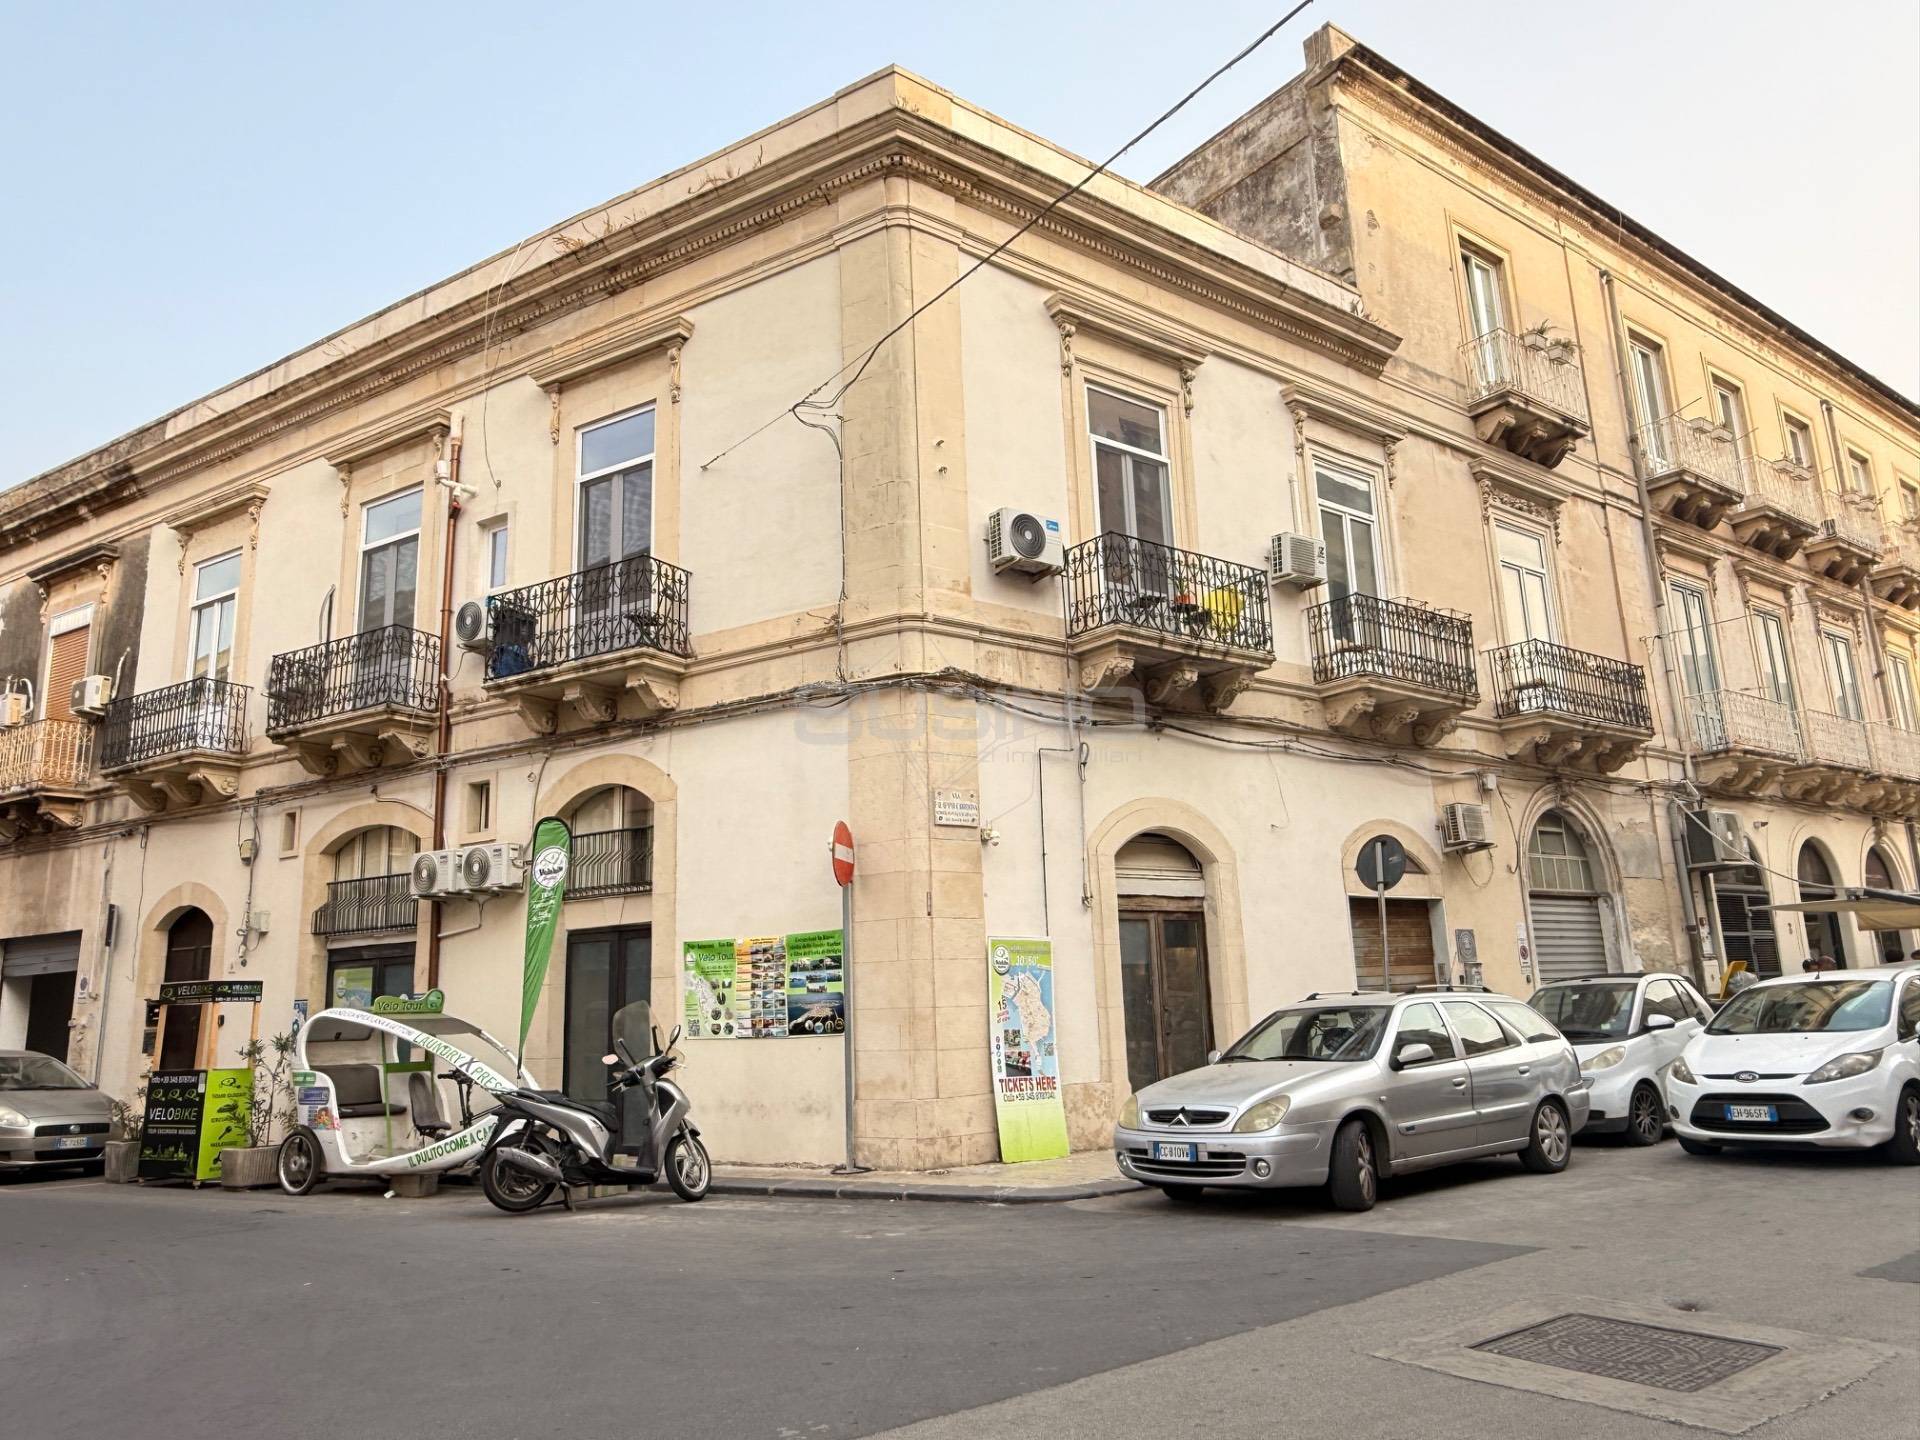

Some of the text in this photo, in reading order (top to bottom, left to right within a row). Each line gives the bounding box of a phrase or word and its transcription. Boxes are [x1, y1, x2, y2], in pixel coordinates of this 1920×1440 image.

[378, 1001, 424, 1011] Velo Tour
[412, 1033, 465, 1064] LAUNDRY
[999, 1076, 1056, 1093] TICKETS HERE
[149, 1107, 198, 1121] VELOBIKE
[408, 1156, 416, 1168] IL
[416, 1145, 444, 1165] PULITO
[443, 1134, 469, 1154] COME
[470, 1132, 477, 1145] A
